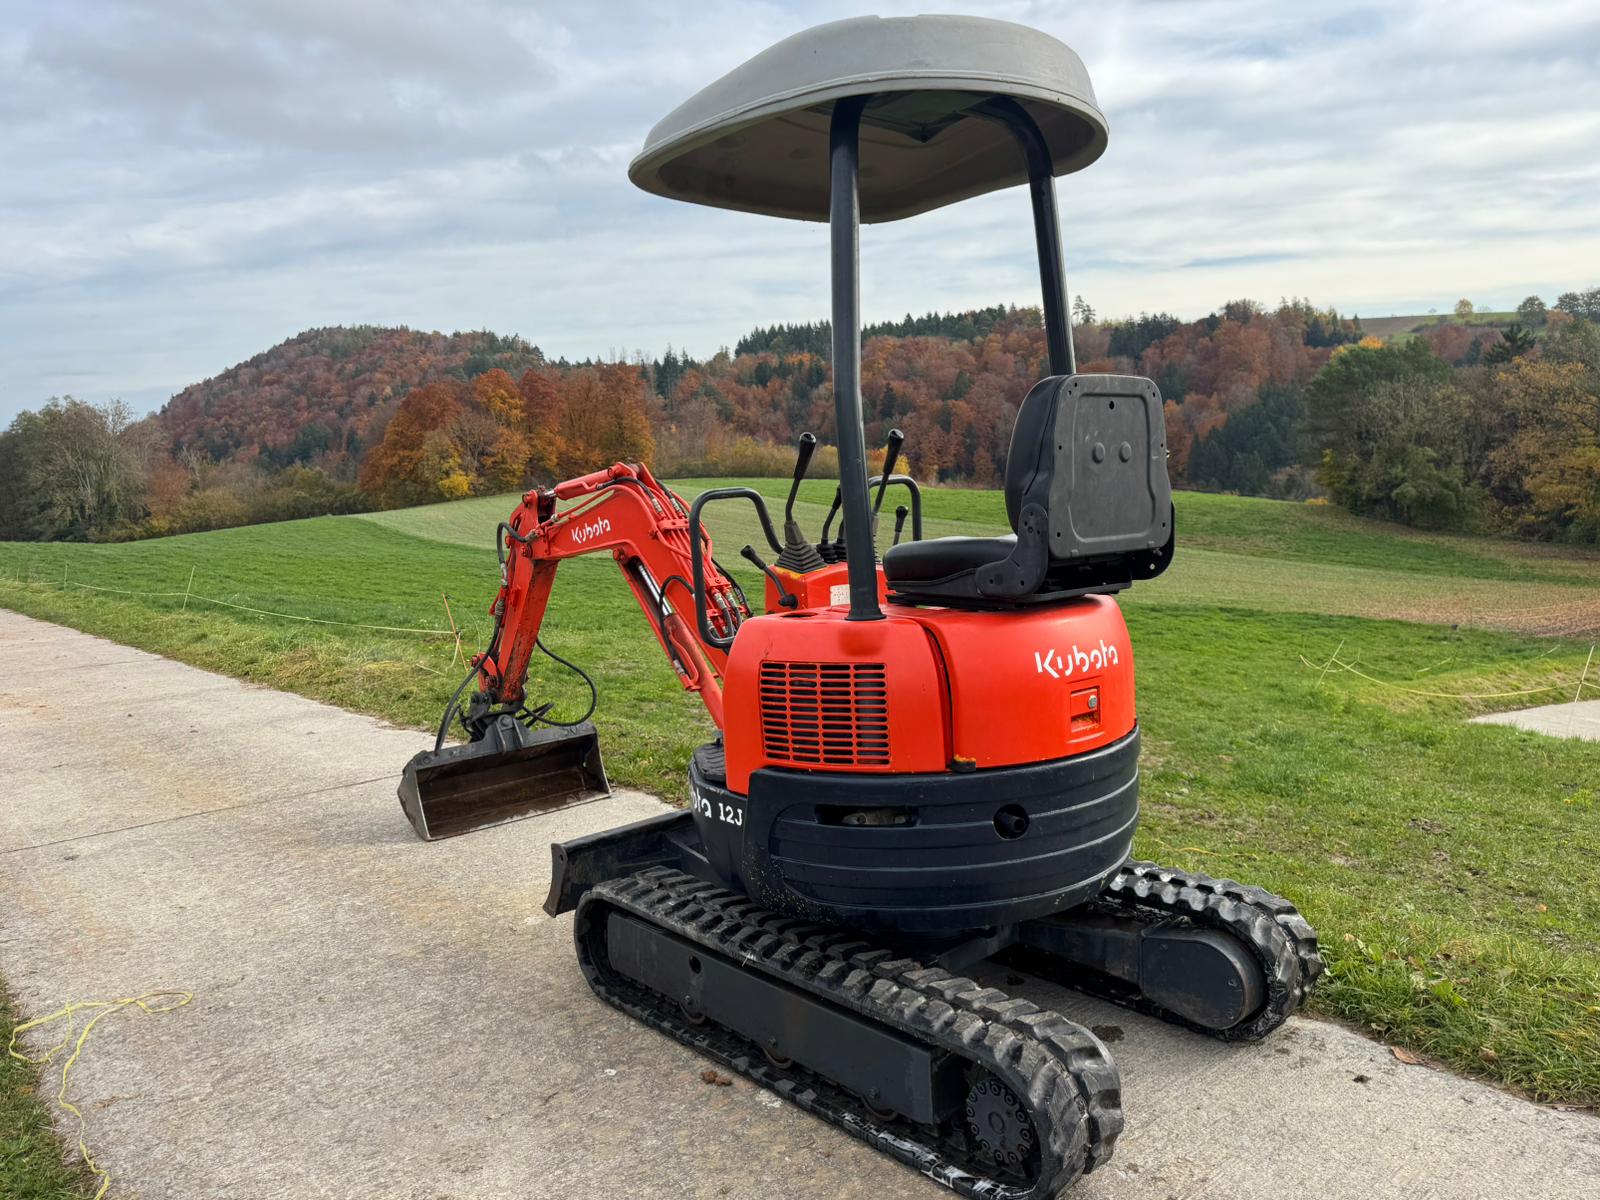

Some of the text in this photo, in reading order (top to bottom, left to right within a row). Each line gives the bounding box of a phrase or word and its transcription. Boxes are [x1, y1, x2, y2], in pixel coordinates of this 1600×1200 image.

[571, 516, 611, 544] Kubota
[1034, 639, 1119, 679] Kubota
[718, 802, 743, 826] 12J
